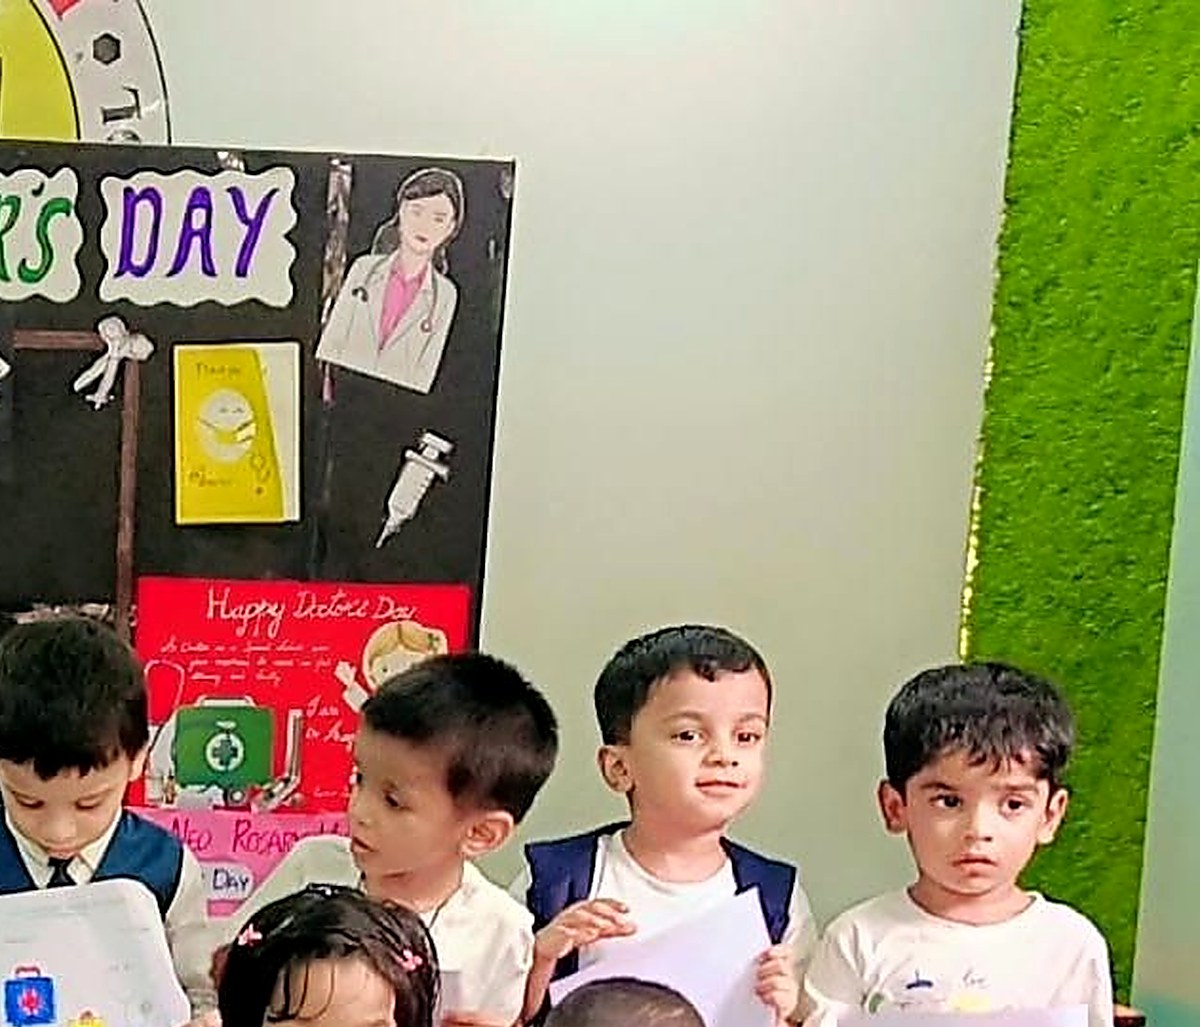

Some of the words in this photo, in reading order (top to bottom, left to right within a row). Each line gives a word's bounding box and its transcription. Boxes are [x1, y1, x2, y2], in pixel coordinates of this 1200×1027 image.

[113, 186, 280, 278] DAY
[207, 585, 286, 639] Happy
[172, 818, 212, 851] NEO
[232, 819, 300, 855] ROSAR
